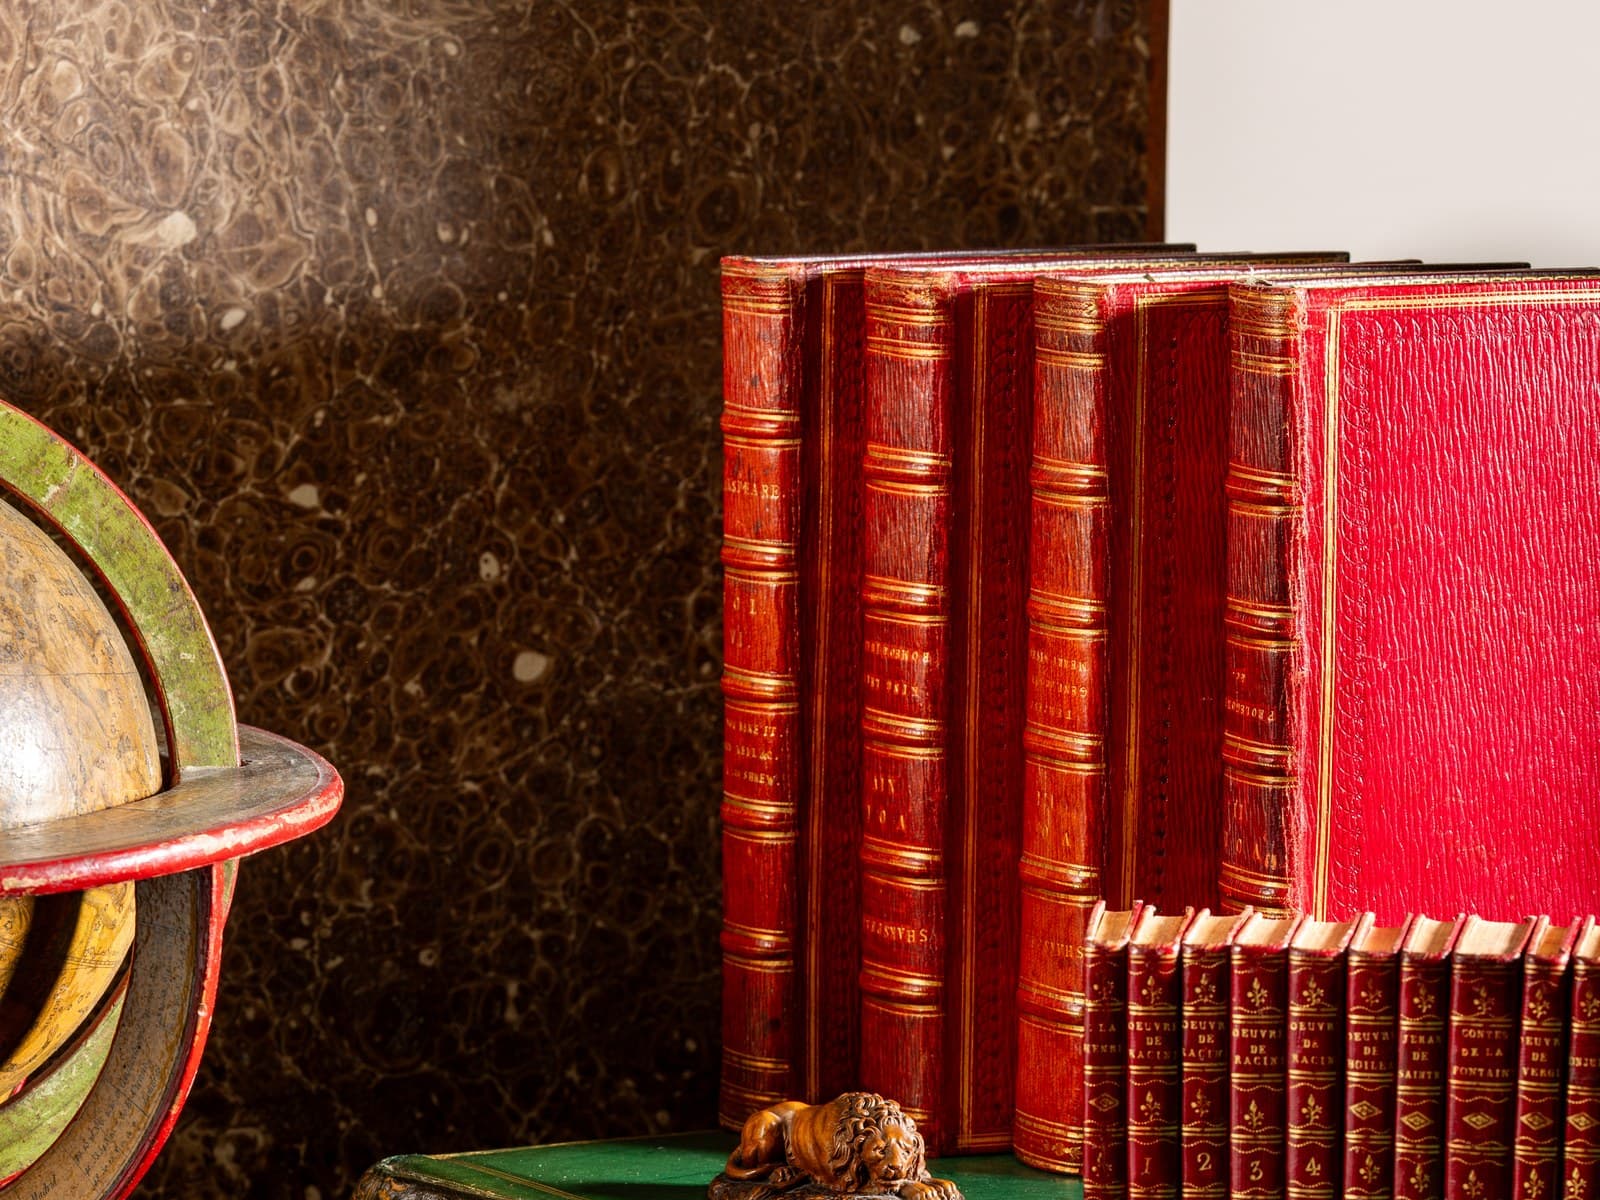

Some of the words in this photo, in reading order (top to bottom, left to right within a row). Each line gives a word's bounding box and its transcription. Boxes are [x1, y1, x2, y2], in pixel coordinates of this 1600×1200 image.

[1146, 1036, 1162, 1046] DE
[1198, 1034, 1214, 1045] DE
[1250, 1045, 1266, 1055] DE
[1461, 1047, 1480, 1057] DE
[1486, 1047, 1503, 1057] LA
[1412, 1051, 1429, 1061] DE
[1532, 1052, 1547, 1062] DE
[1452, 1065, 1510, 1078] FONTAIN
[1197, 1152, 1212, 1172] 2
[1305, 1156, 1321, 1176] 4
[1250, 1160, 1264, 1181] 3
